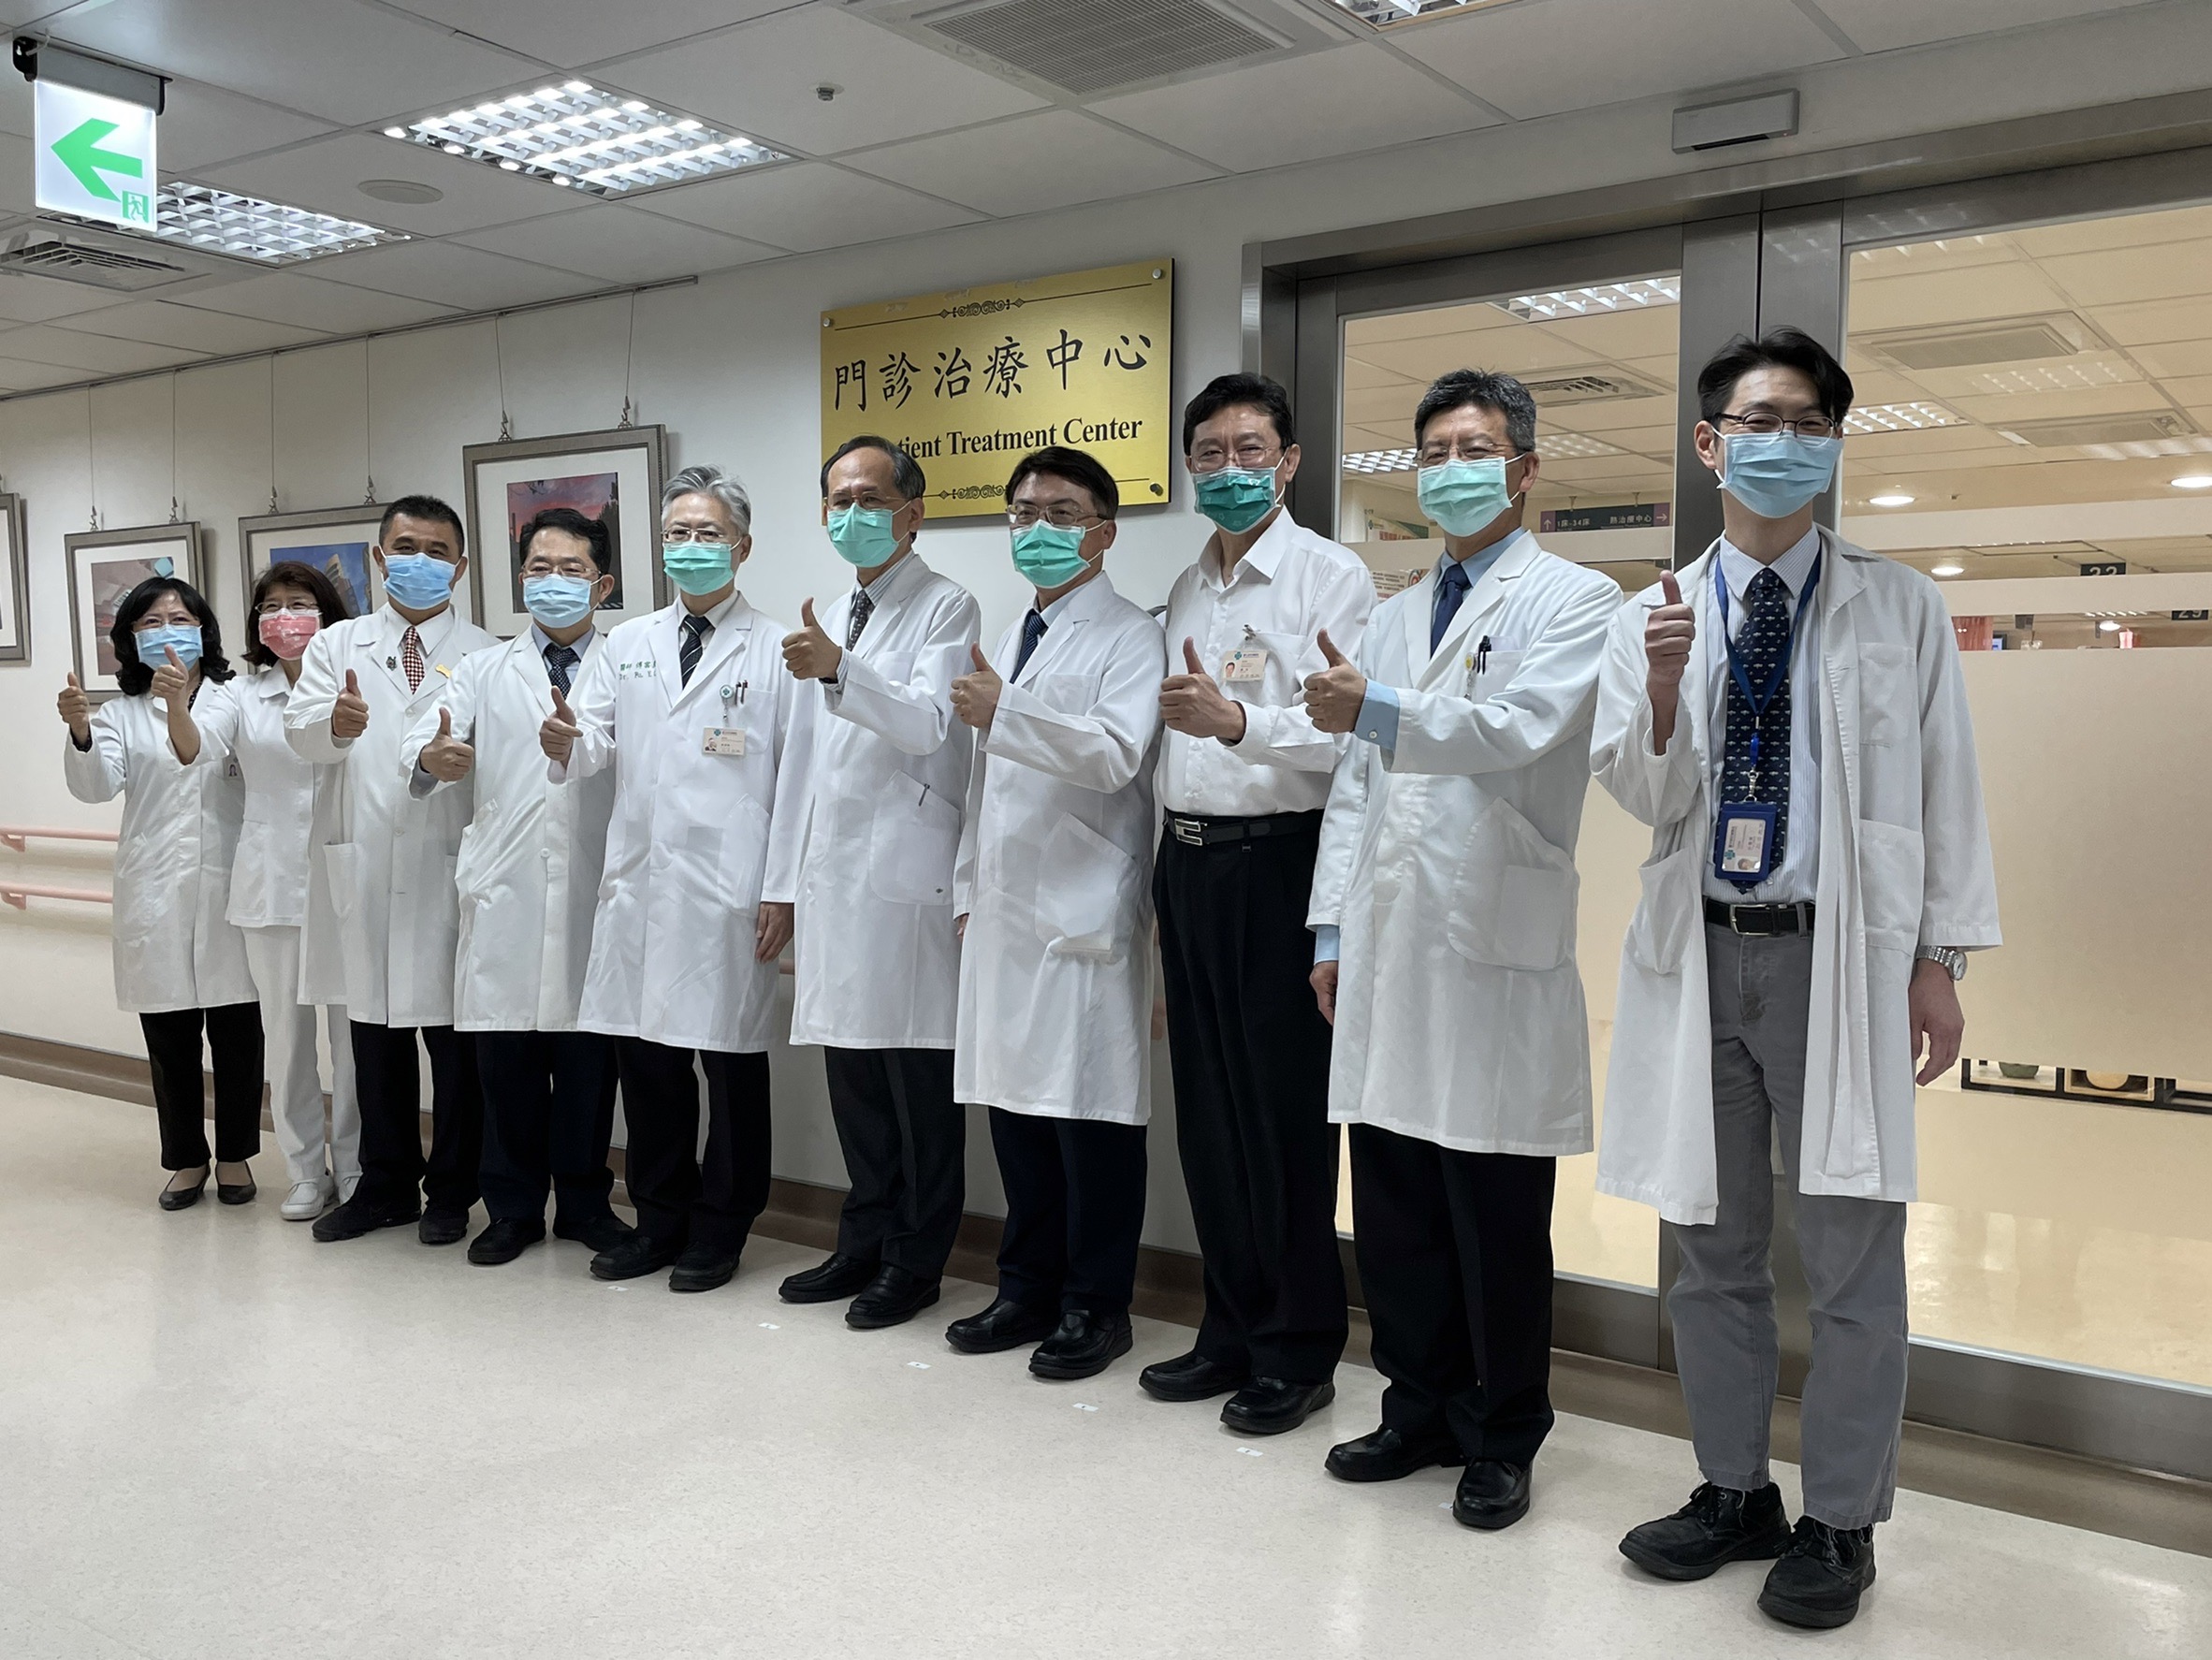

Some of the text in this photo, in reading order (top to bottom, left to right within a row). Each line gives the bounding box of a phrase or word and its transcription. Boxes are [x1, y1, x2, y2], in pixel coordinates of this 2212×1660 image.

[835, 328, 1152, 412] 門診治療中心
[946, 423, 1056, 456] Treatment
[1063, 417, 1143, 444] Center
